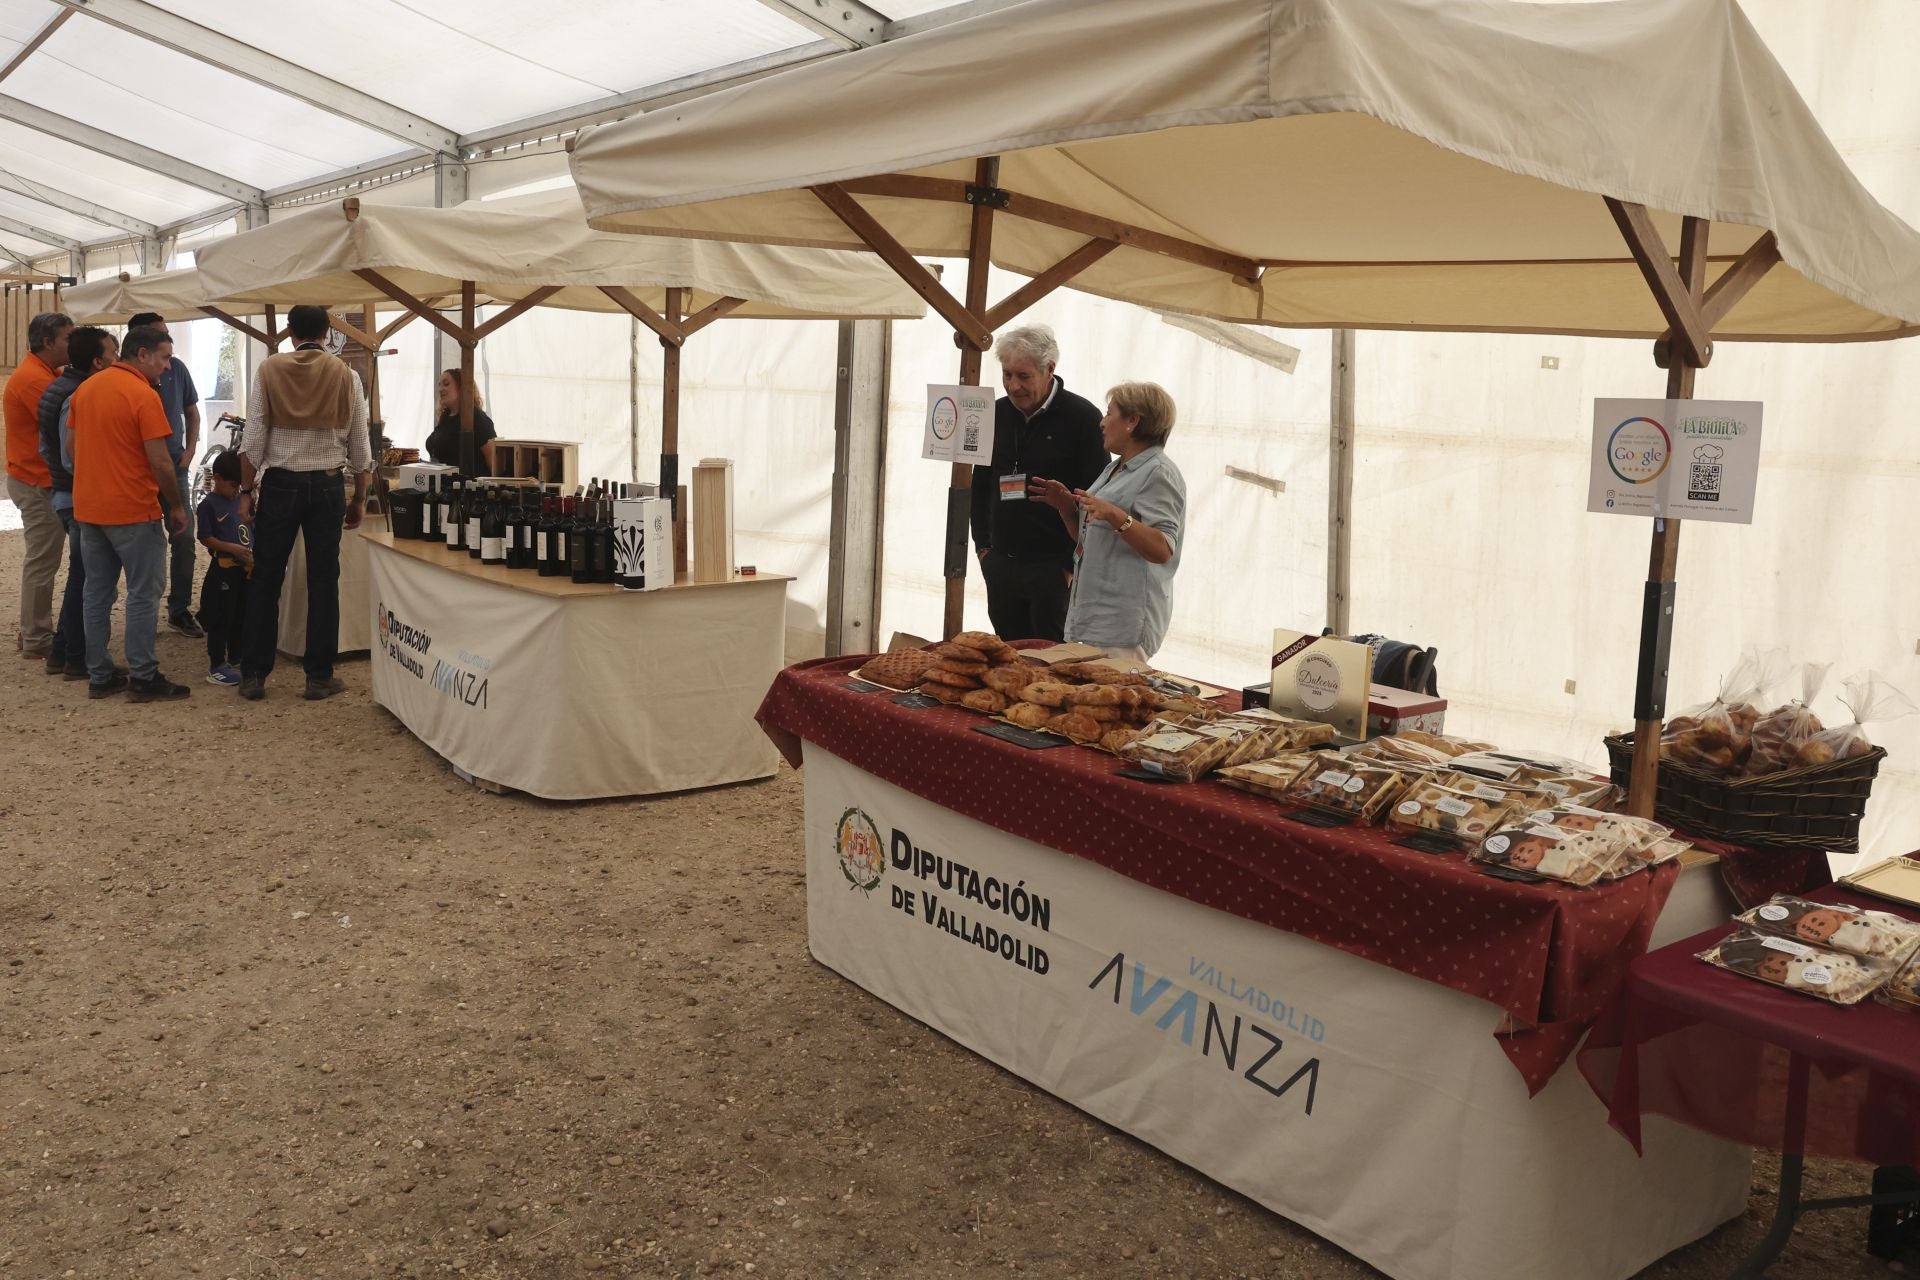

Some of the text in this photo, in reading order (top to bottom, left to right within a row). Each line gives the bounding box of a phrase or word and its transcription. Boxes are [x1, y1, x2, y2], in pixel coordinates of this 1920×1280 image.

[1614, 446, 1662, 466] Google
[1689, 491, 1707, 499] SCAN
[387, 610, 431, 656] DIPUTACIÓN
[1276, 639, 1308, 662] GANADOR
[890, 827, 1051, 932] DIPUTACIÓN
[891, 884, 1050, 976] DE VALLADOLID
[1188, 956, 1327, 1043] VALLADOLID
[1088, 952, 1321, 1117] AVANZA
